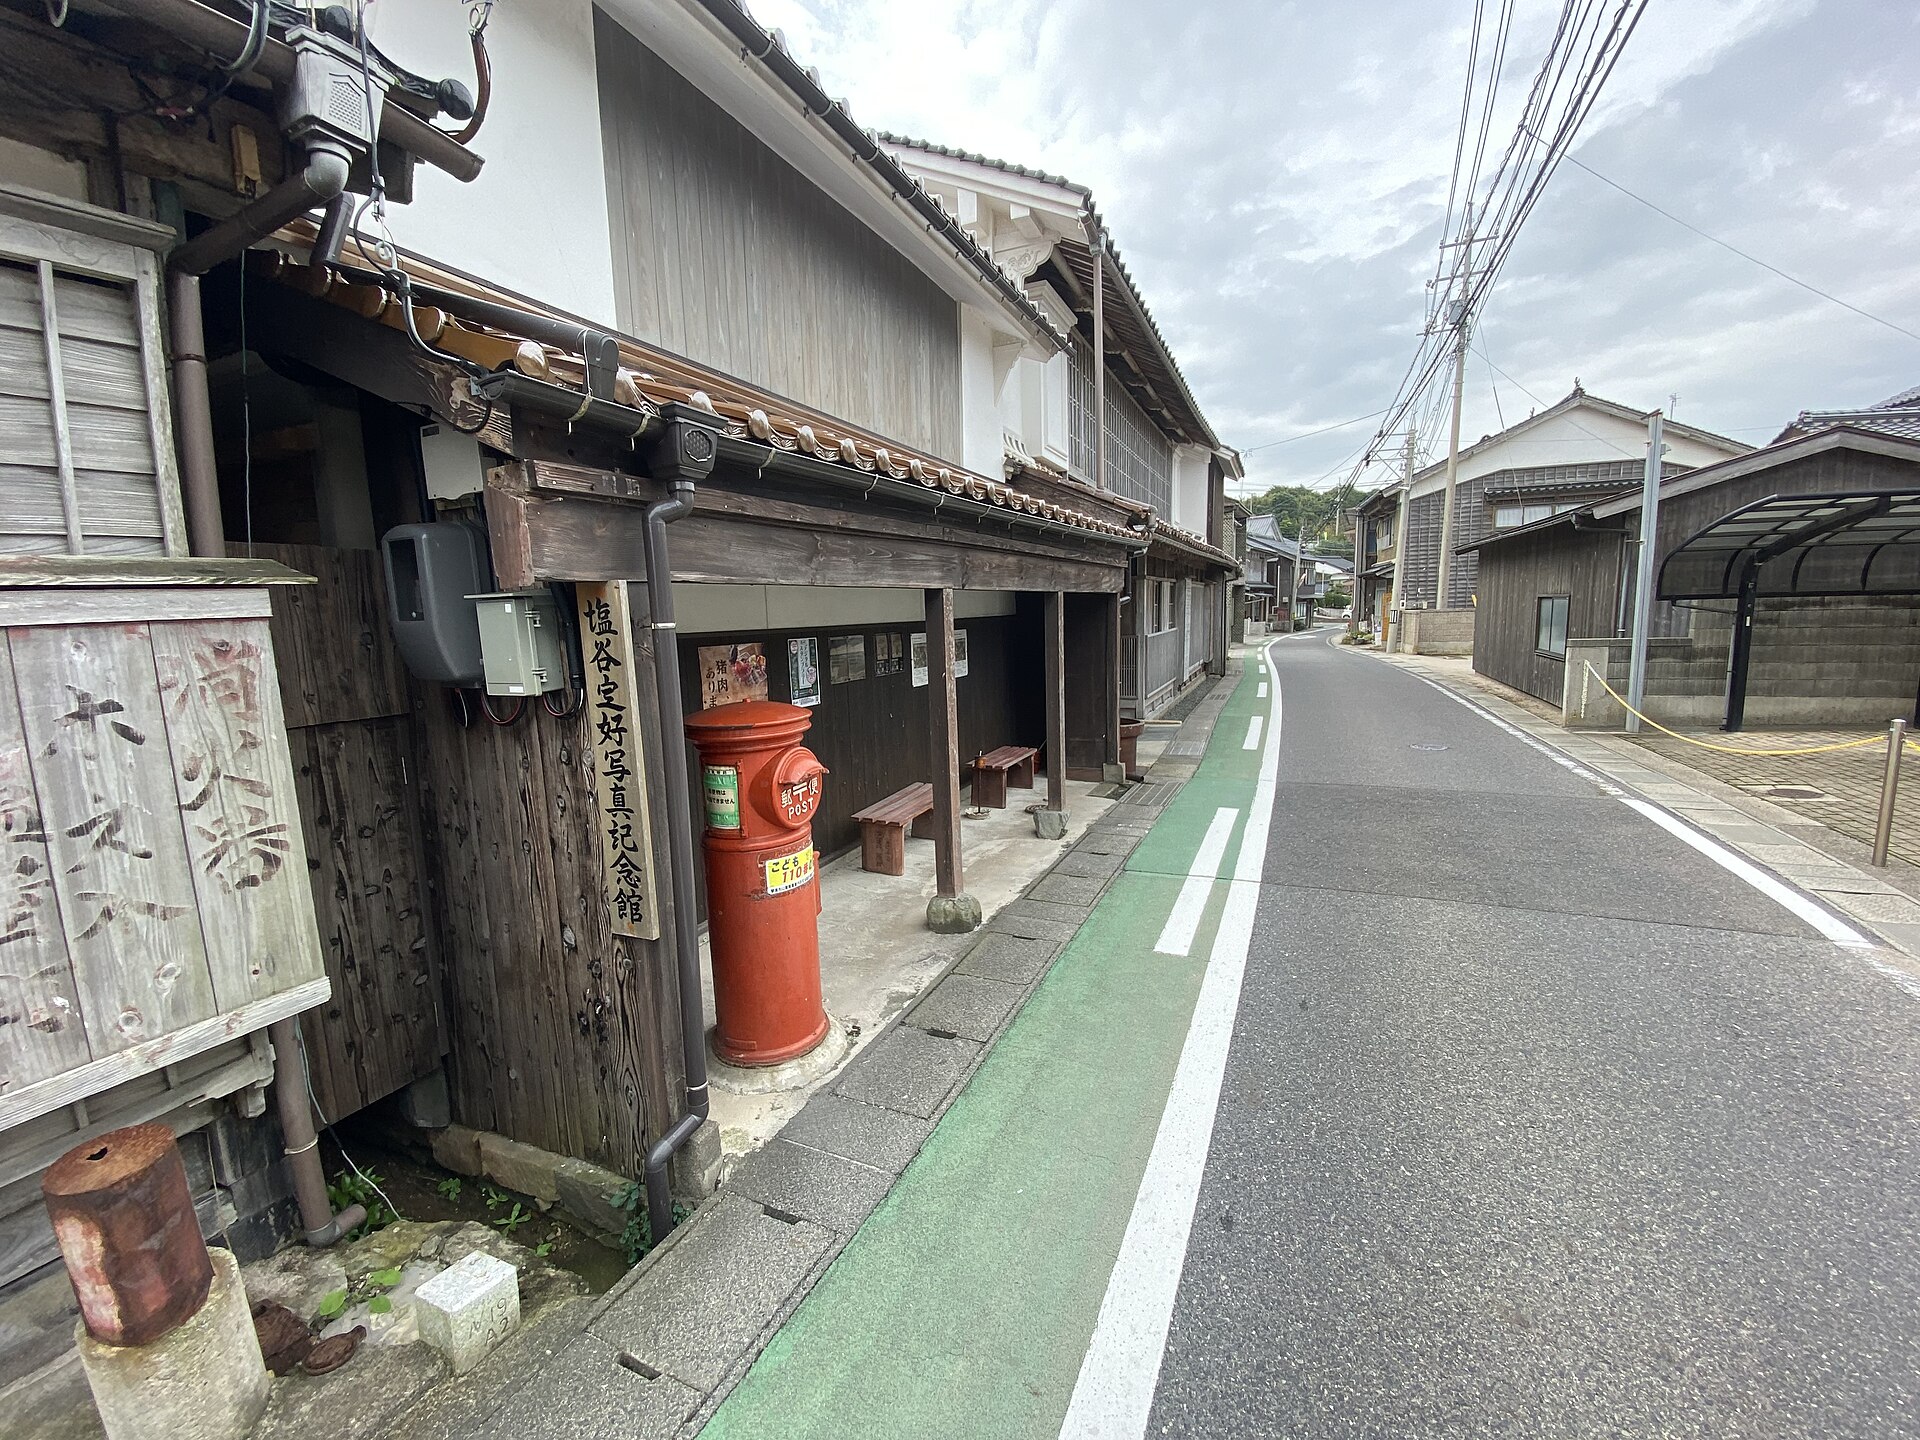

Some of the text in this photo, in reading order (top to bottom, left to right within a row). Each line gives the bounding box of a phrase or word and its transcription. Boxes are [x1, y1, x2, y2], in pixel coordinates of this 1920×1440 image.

[583, 598, 644, 925] 塩谷定好写真記念館
[788, 797, 814, 820] POST
[771, 856, 799, 873] こども
